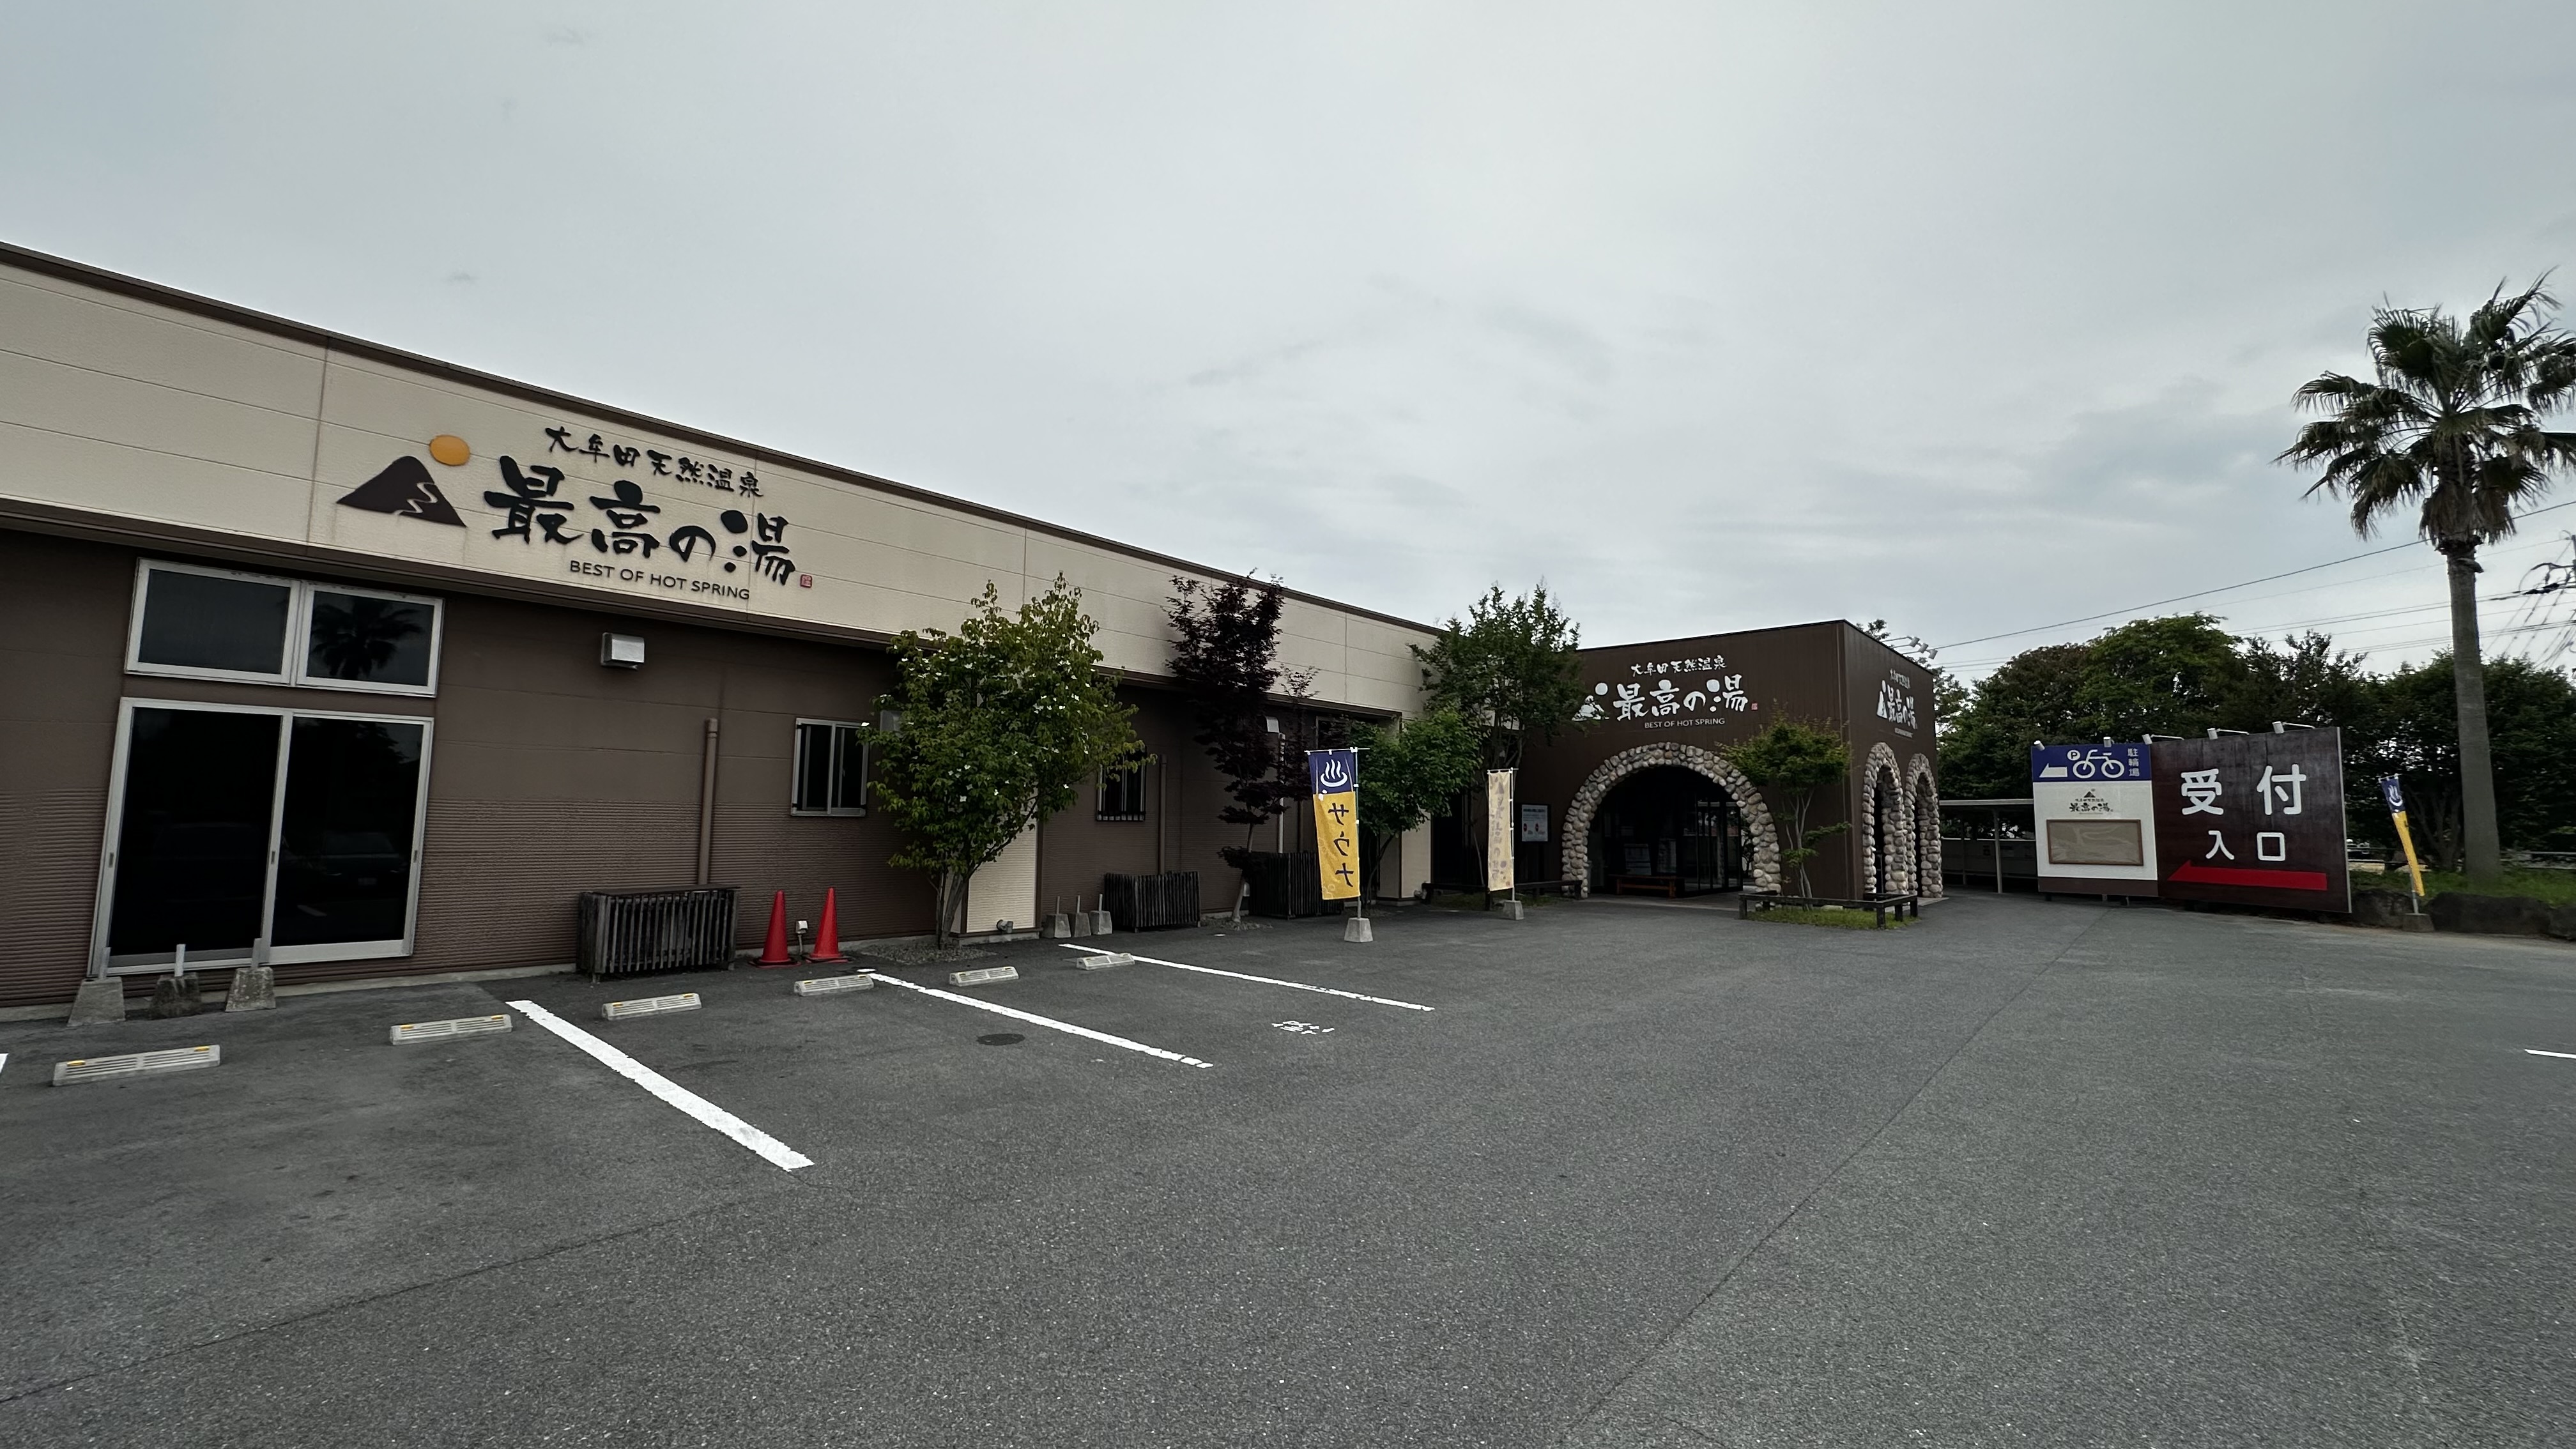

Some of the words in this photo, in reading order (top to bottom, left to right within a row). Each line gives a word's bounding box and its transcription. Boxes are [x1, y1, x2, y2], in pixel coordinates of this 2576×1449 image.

[545, 425, 764, 498] 大牟田天然温泉
[484, 455, 797, 586] 最高の湯
[570, 560, 616, 578] BEST
[620, 568, 645, 583] OF
[650, 573, 687, 590] HOT
[691, 580, 751, 600] SPRING
[1630, 655, 1728, 678] 大牟田天然温泉
[1613, 673, 1749, 721] 最高の湯
[1644, 721, 1663, 729] BEST
[1694, 717, 1726, 726] SPRING
[2128, 747, 2140, 777] 駐輪場
[2181, 763, 2307, 816] 受付
[2205, 830, 2286, 862] 入口
